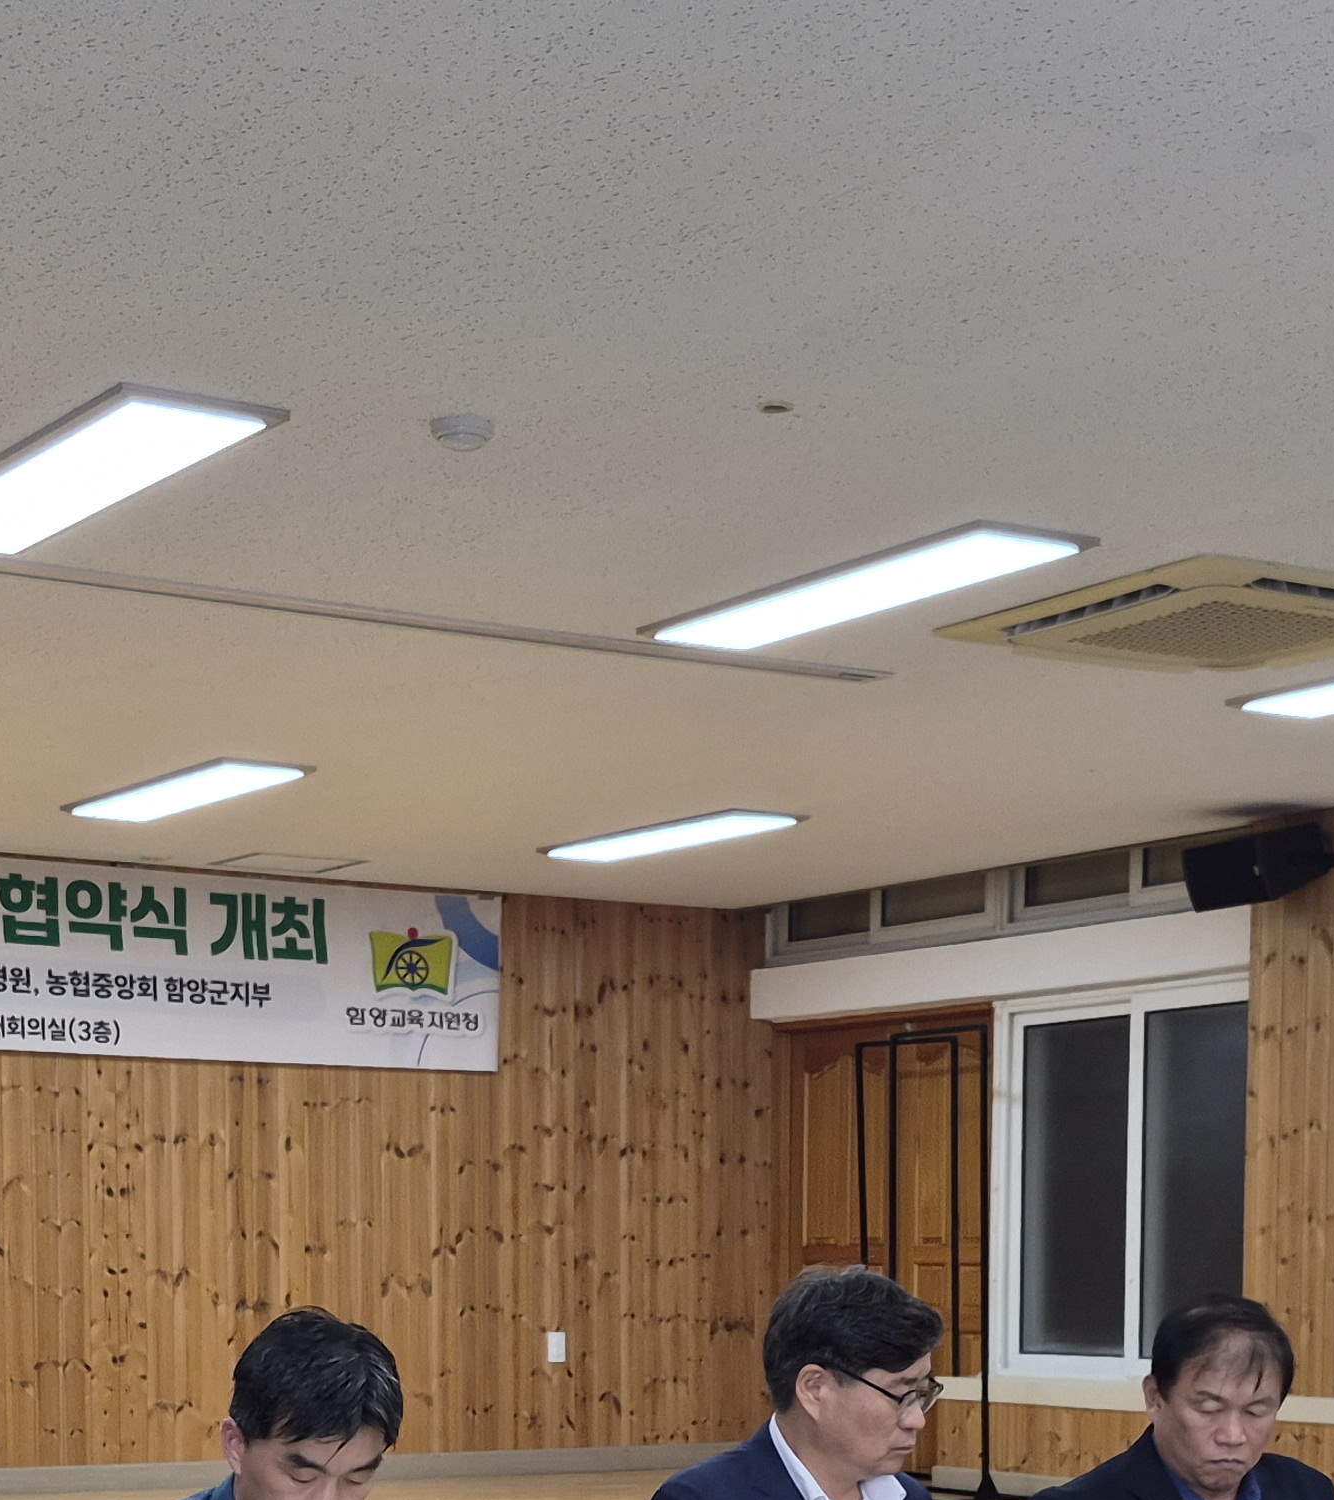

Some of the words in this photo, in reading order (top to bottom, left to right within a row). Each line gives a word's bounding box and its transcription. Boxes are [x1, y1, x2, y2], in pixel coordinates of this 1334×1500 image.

[208, 890, 330, 965] 개최
[45, 968, 158, 1002] 농협중앙회
[163, 976, 272, 1008] 함양군지부
